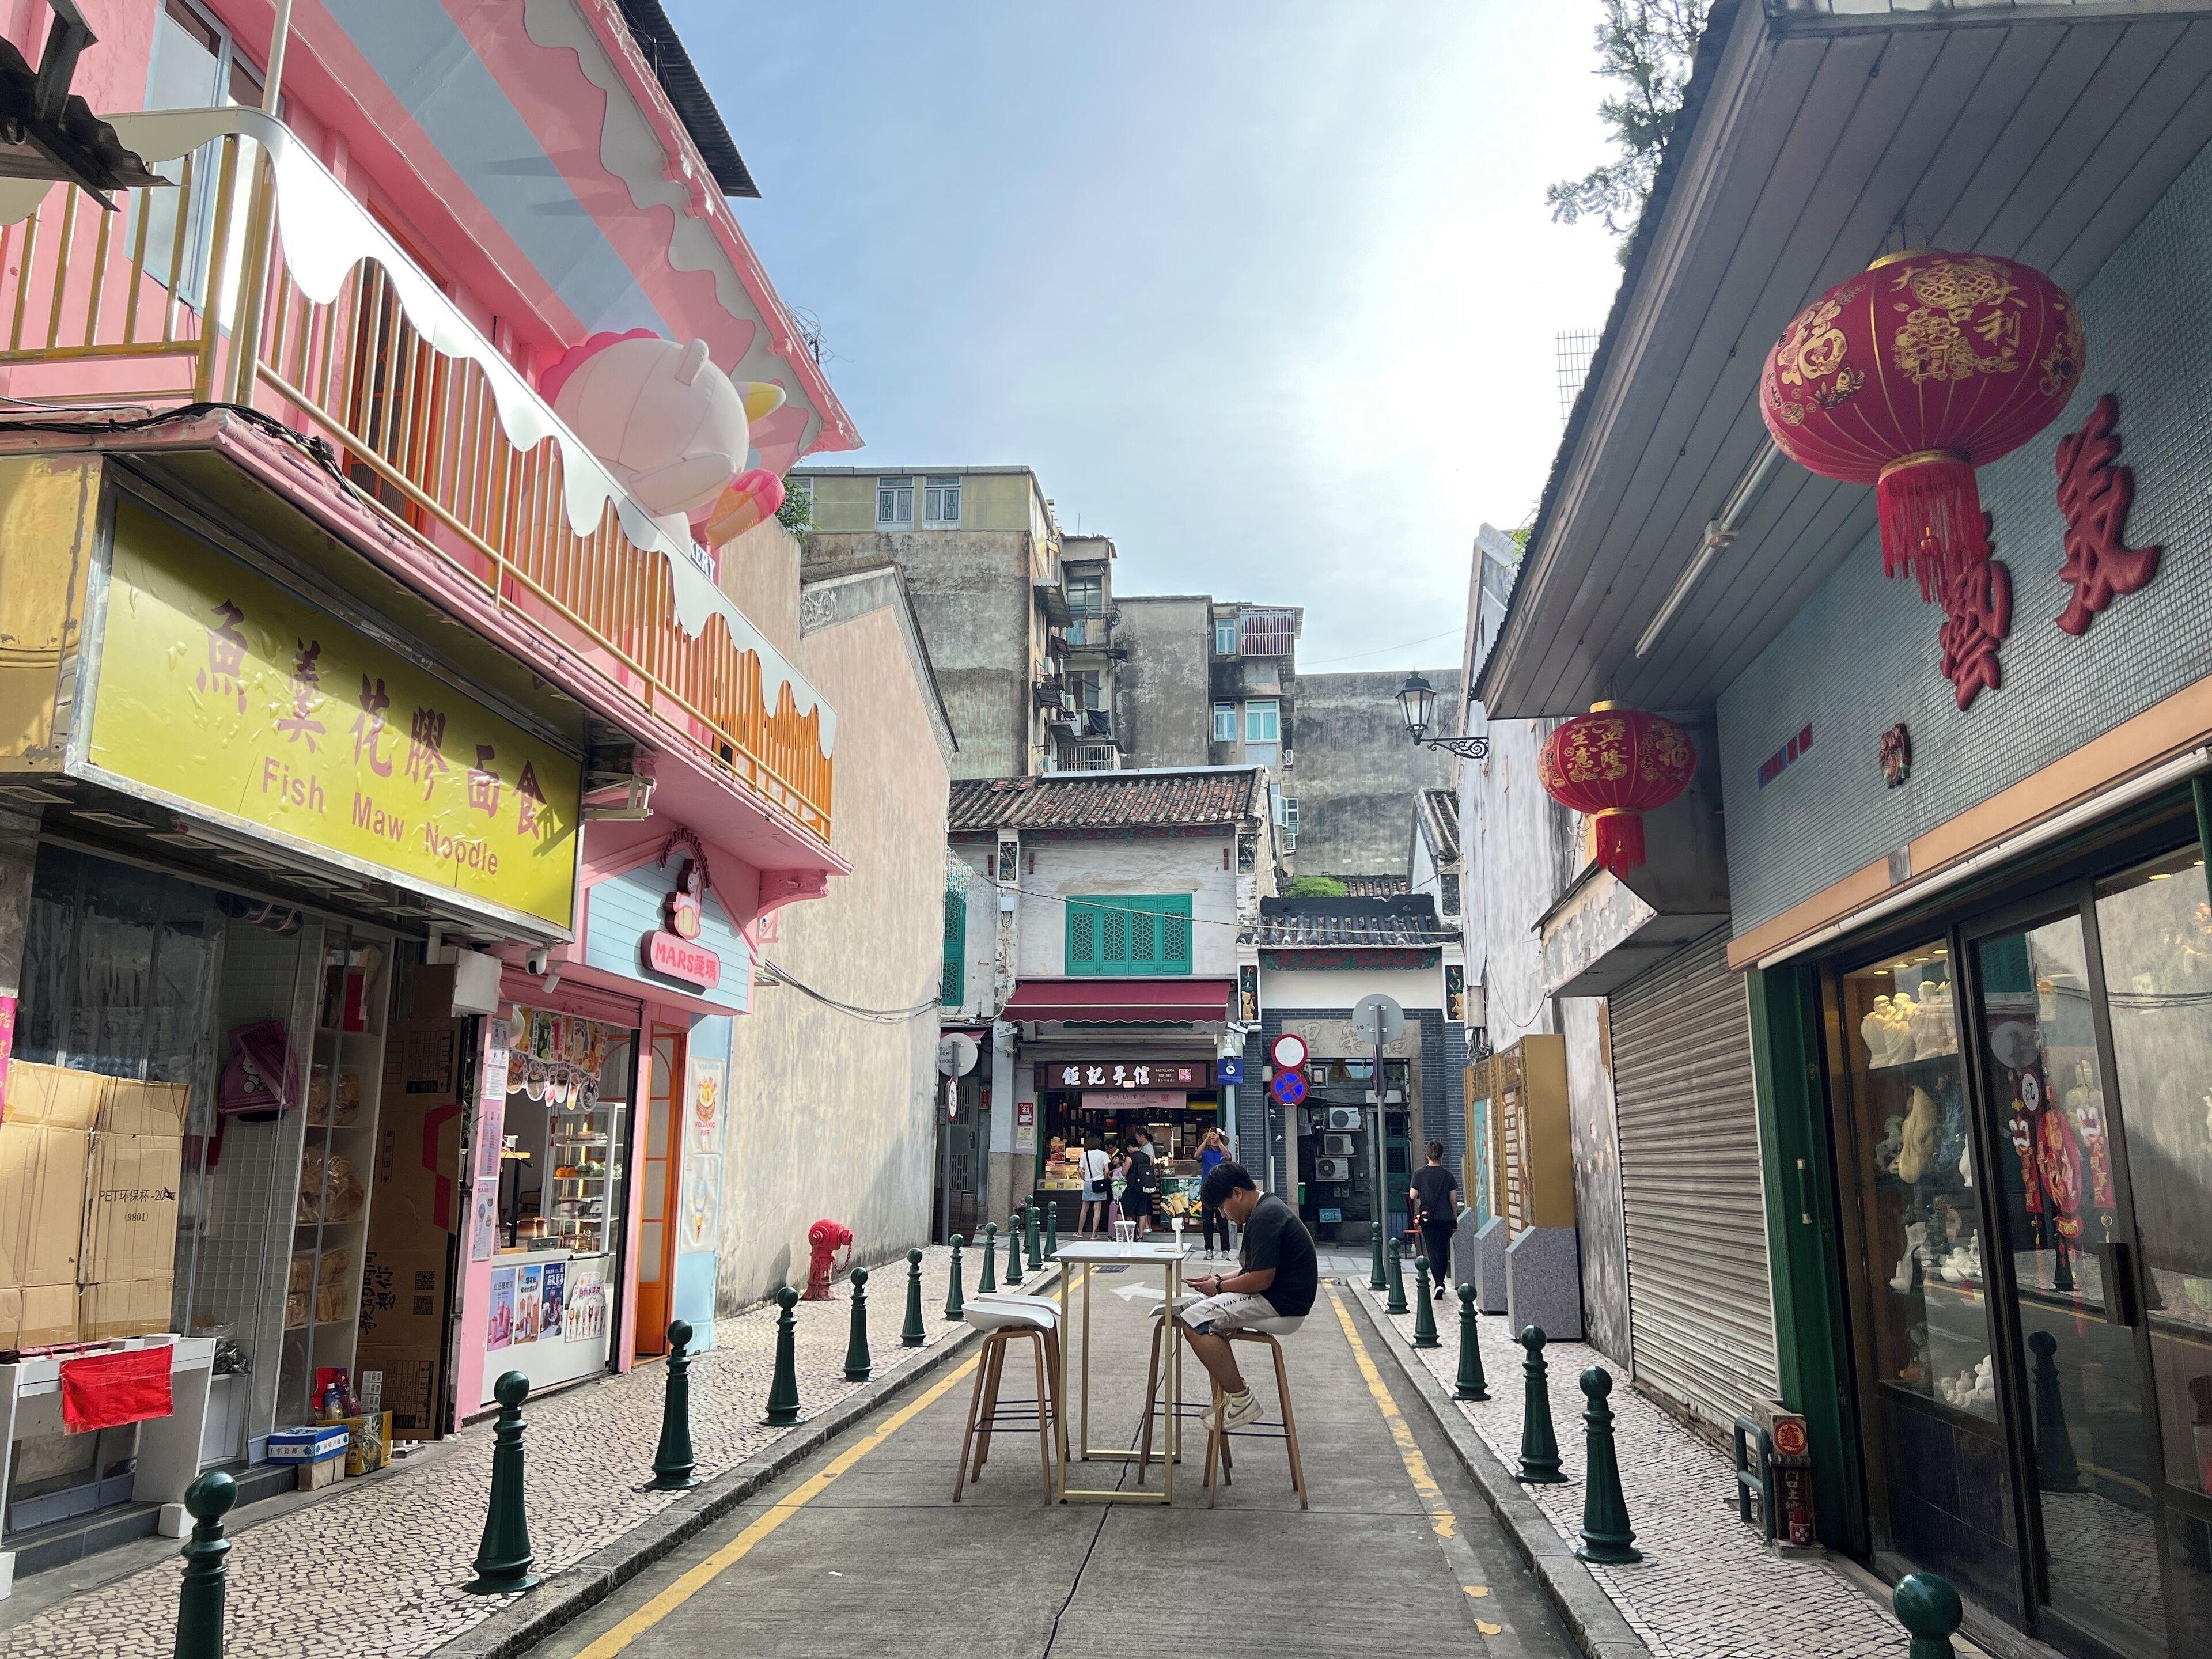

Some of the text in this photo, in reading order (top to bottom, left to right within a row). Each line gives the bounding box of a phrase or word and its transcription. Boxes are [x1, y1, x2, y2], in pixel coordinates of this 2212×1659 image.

[196, 598, 548, 840] 魚羹花膠面食
[262, 756, 499, 876] Fish Maw Noodle
[1062, 1065, 1150, 1086] 鉅記手信
[100, 1189, 150, 1203] PET环保杯
[124, 1211, 149, 1222] (9801)
